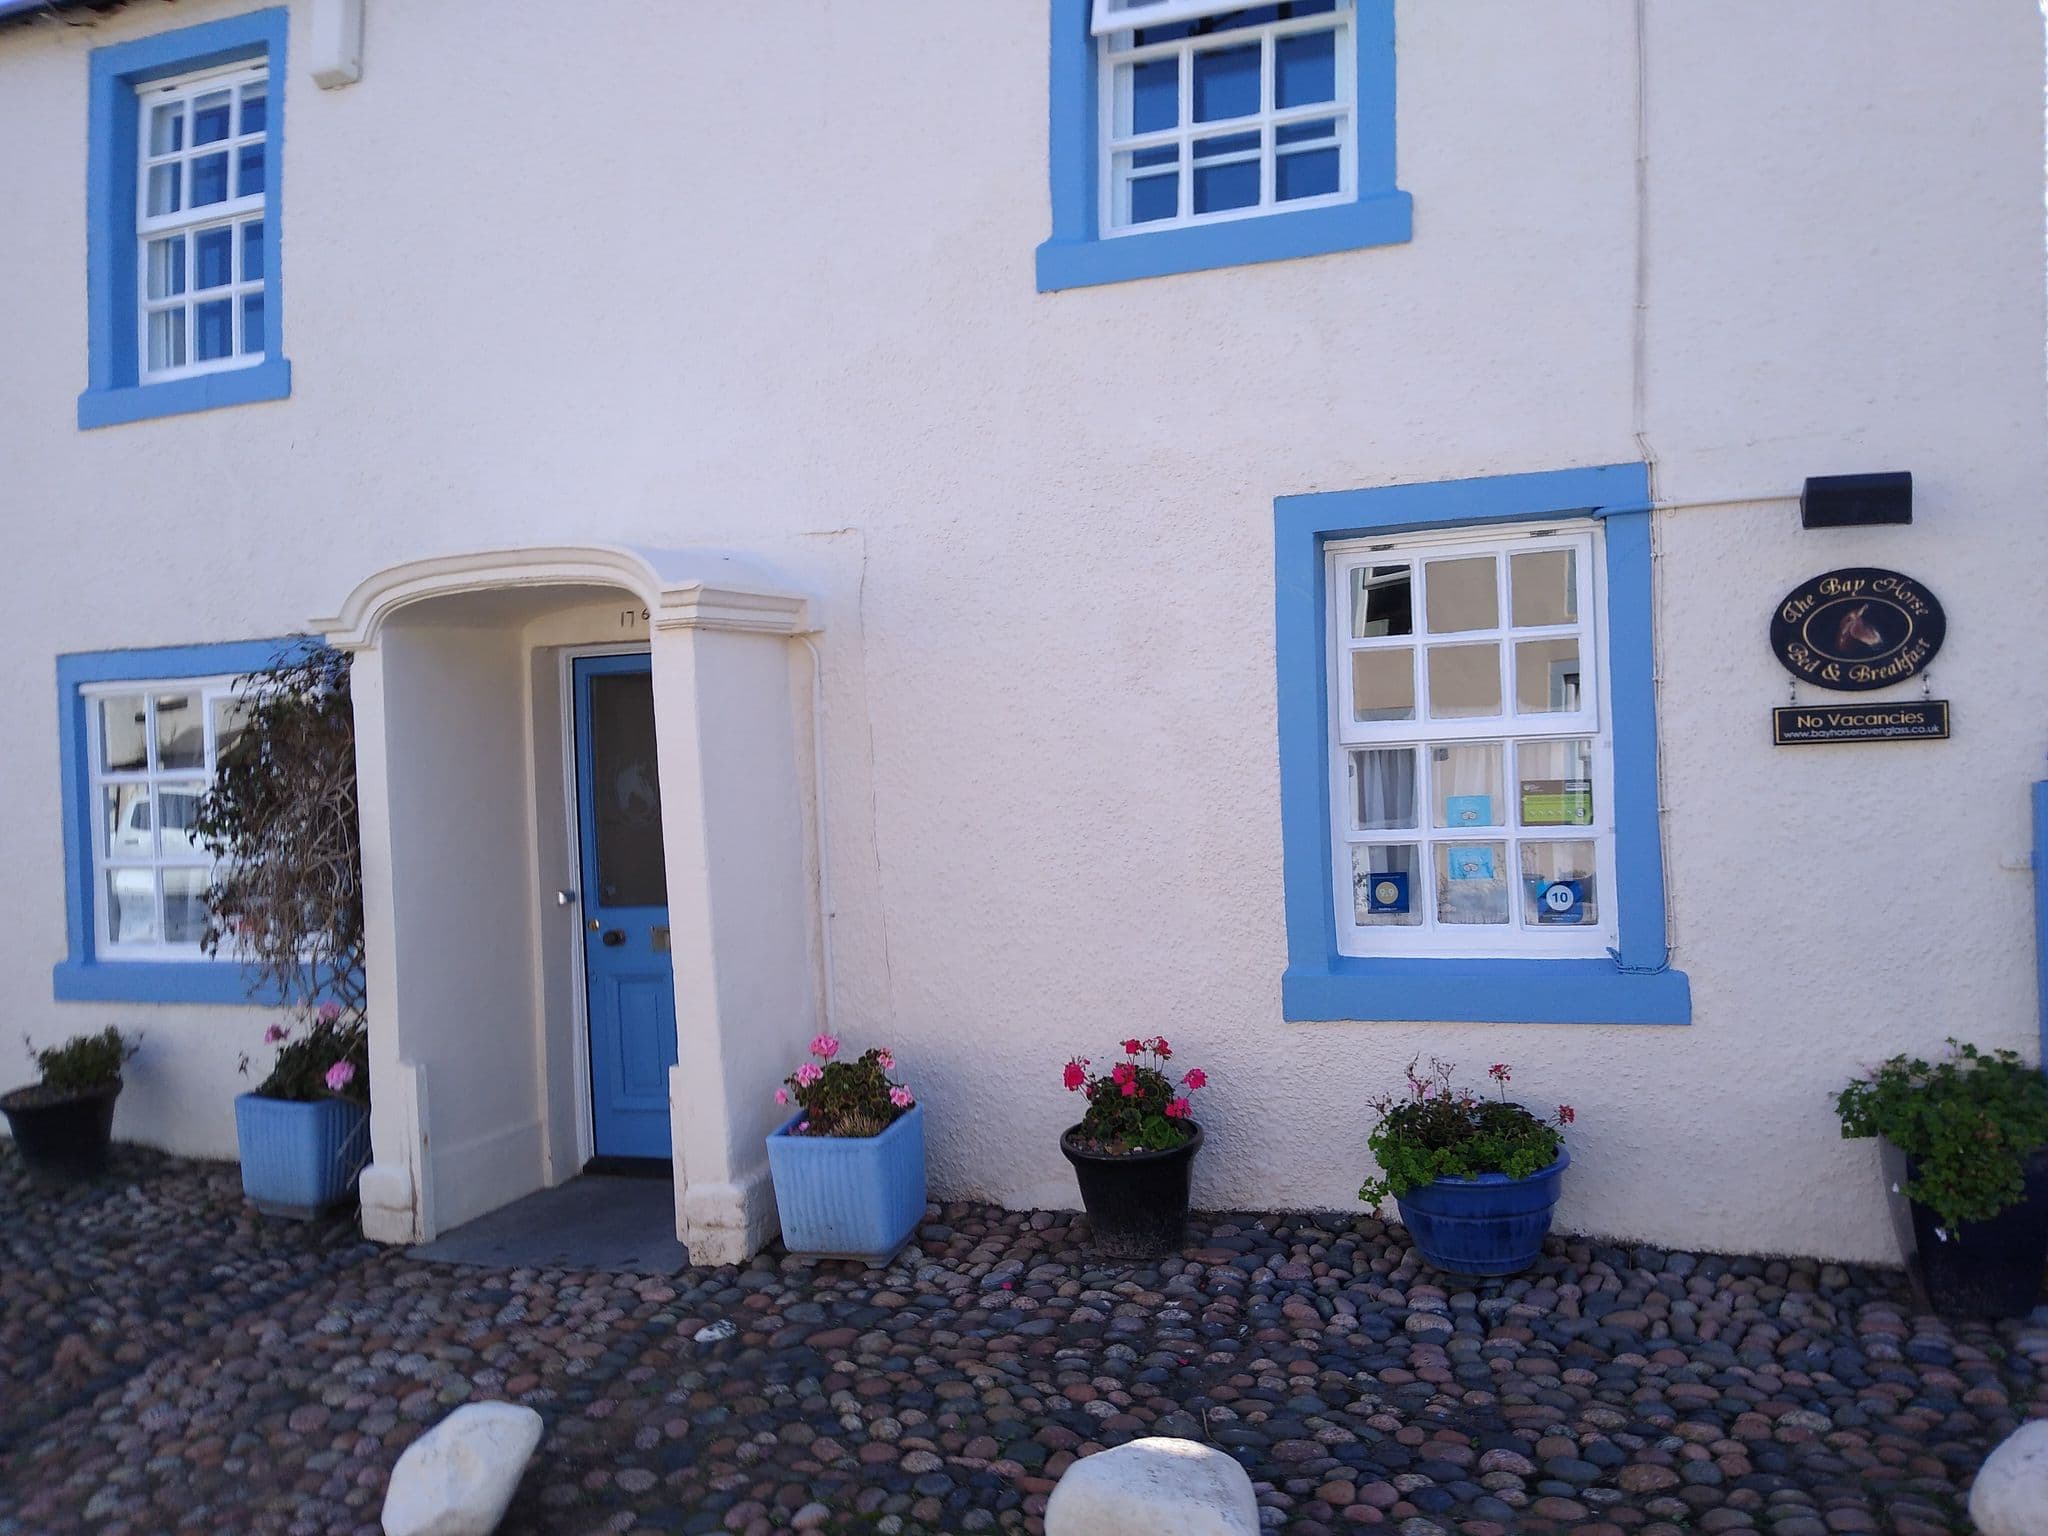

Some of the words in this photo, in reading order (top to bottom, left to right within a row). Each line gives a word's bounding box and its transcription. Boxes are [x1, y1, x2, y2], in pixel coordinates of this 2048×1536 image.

[1783, 594, 1815, 623] The
[1820, 577, 1865, 597] Bay
[1873, 577, 1928, 616] Horse
[1787, 642, 1821, 672] Bed
[1821, 663, 1840, 681] &
[1848, 638, 1931, 682] Breakfast
[1797, 715, 1823, 728] No
[1828, 710, 1924, 726] Vacancies
[1552, 892, 1568, 903] 10
